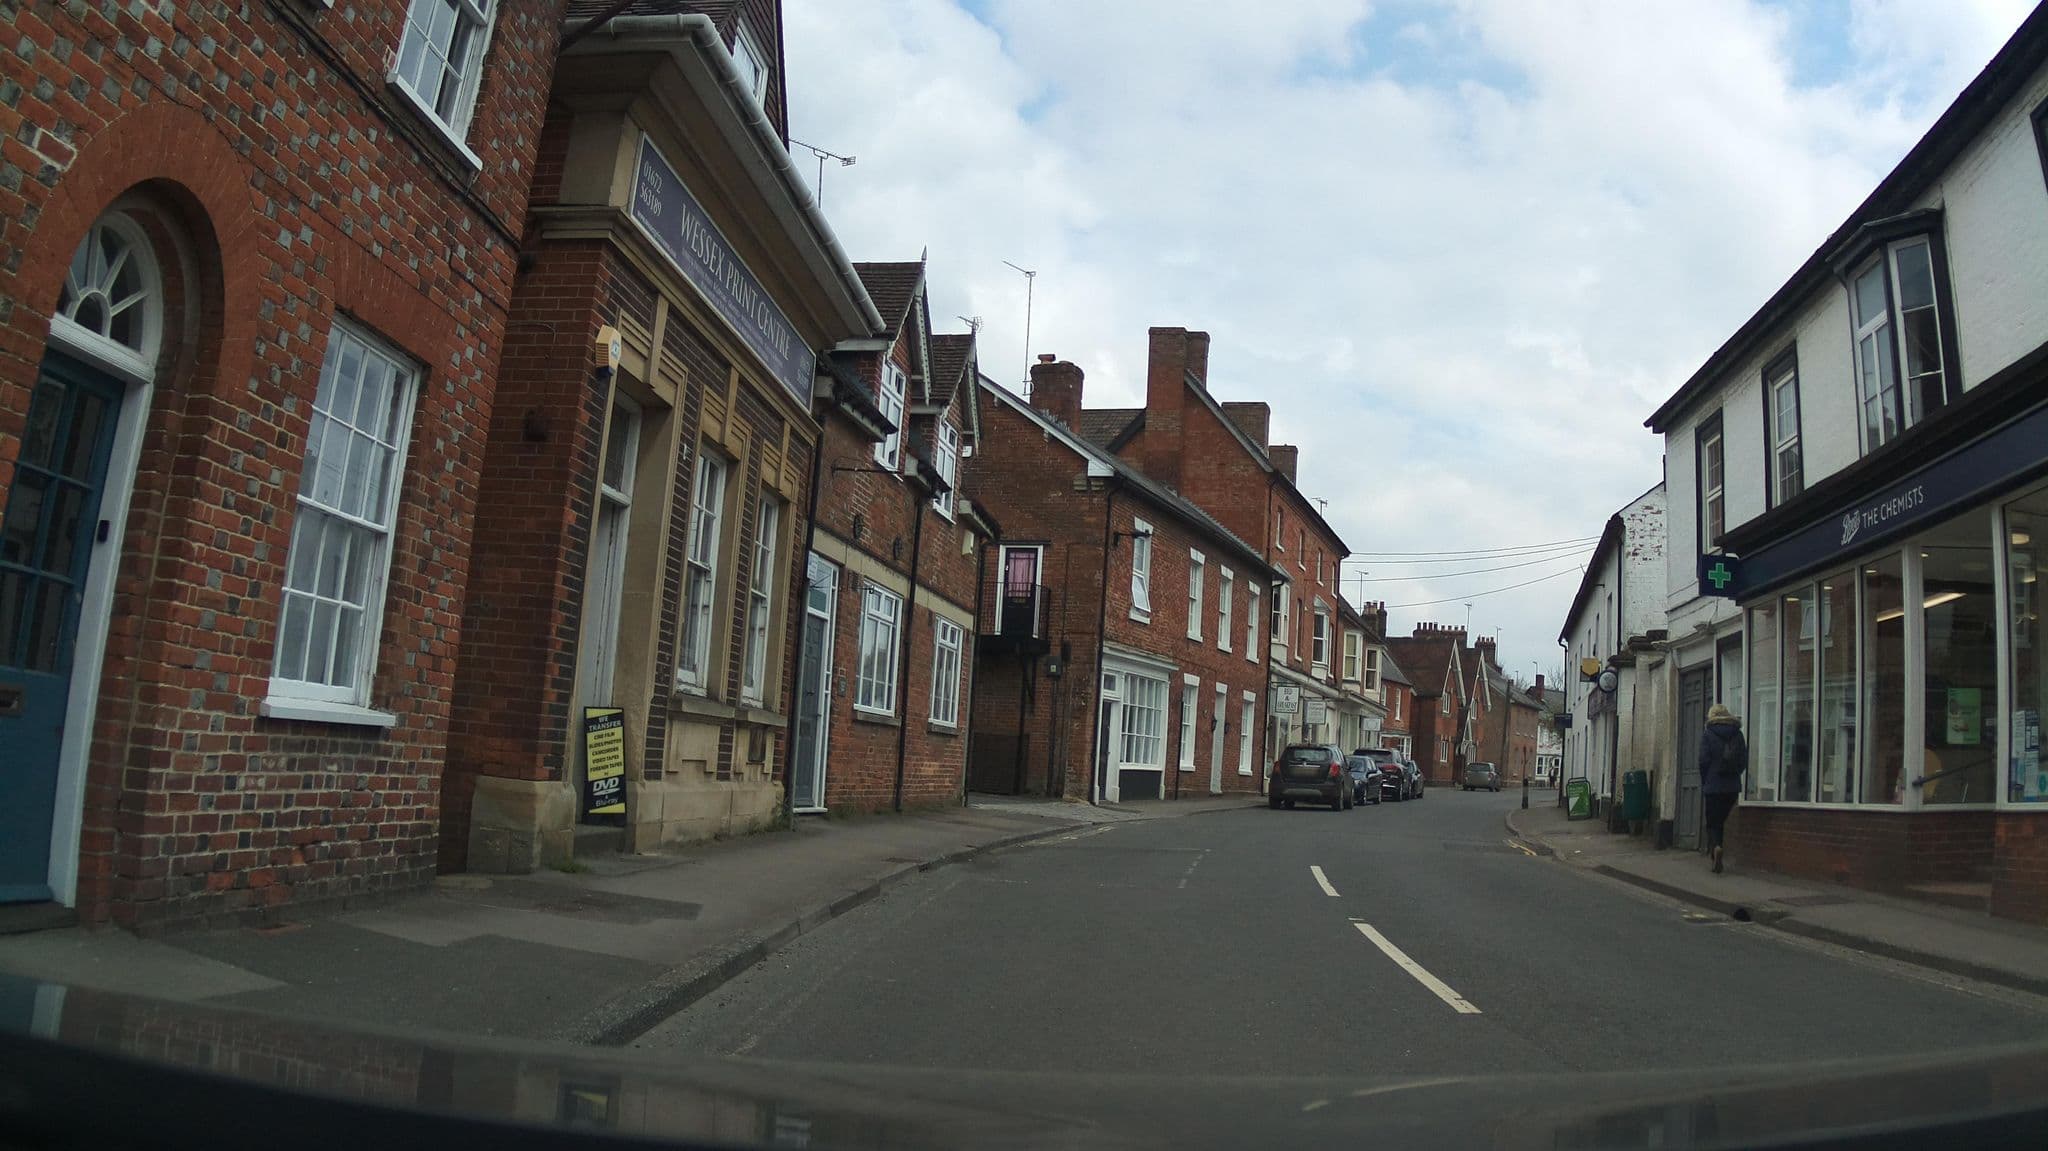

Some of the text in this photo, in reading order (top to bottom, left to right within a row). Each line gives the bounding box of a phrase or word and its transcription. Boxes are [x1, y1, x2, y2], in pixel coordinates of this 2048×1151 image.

[644, 161, 662, 194] 01672
[681, 204, 725, 281] WESSEX
[726, 260, 758, 318] PRINT
[757, 301, 790, 361] CENTRE
[1841, 485, 1924, 546] Boots THE CHEMISTS
[589, 720, 621, 732] TRANSFER
[593, 777, 619, 792] DVD
